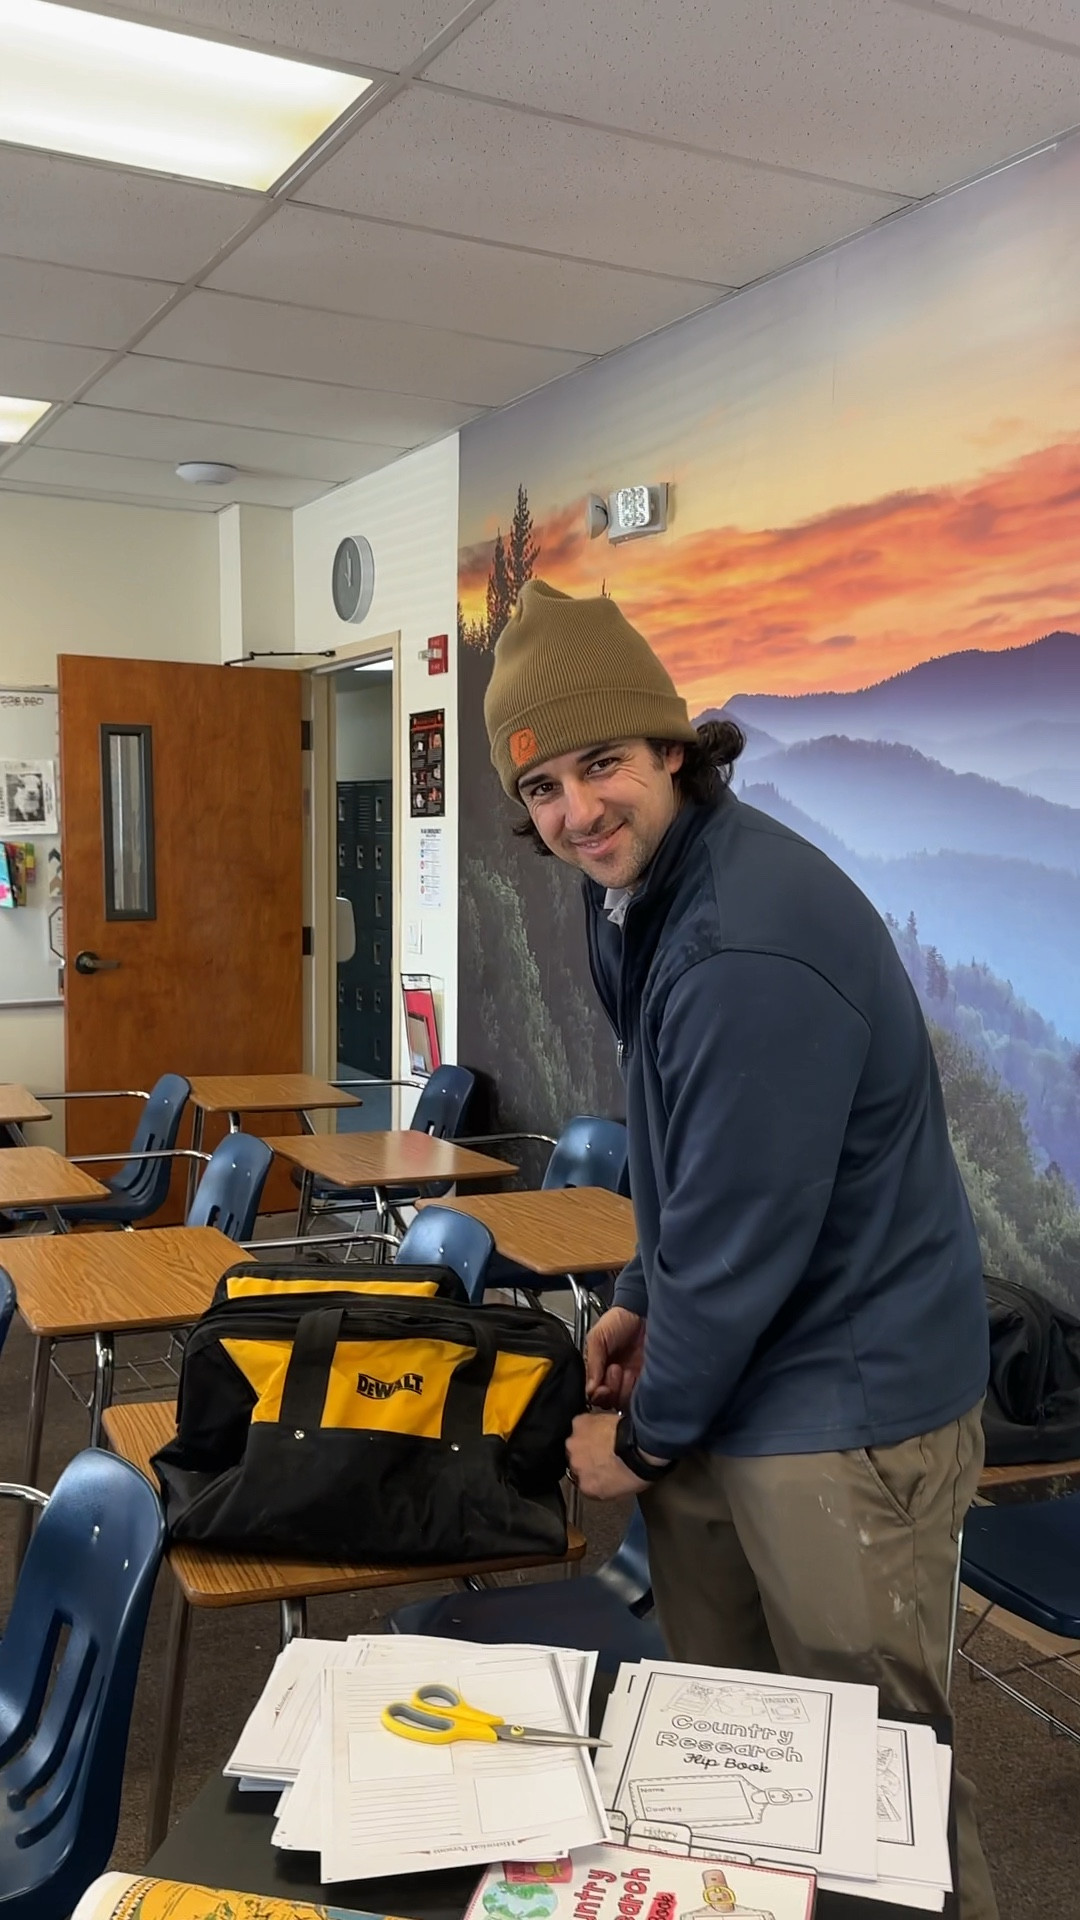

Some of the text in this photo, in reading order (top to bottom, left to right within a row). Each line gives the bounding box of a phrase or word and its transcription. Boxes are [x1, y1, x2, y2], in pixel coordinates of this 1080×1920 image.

[357, 1373, 423, 1399] DEWALT
[671, 1714, 793, 1745] Country
[656, 1731, 803, 1762] Research
[683, 1753, 772, 1773] Flip Book
[643, 1826, 679, 1839] History
